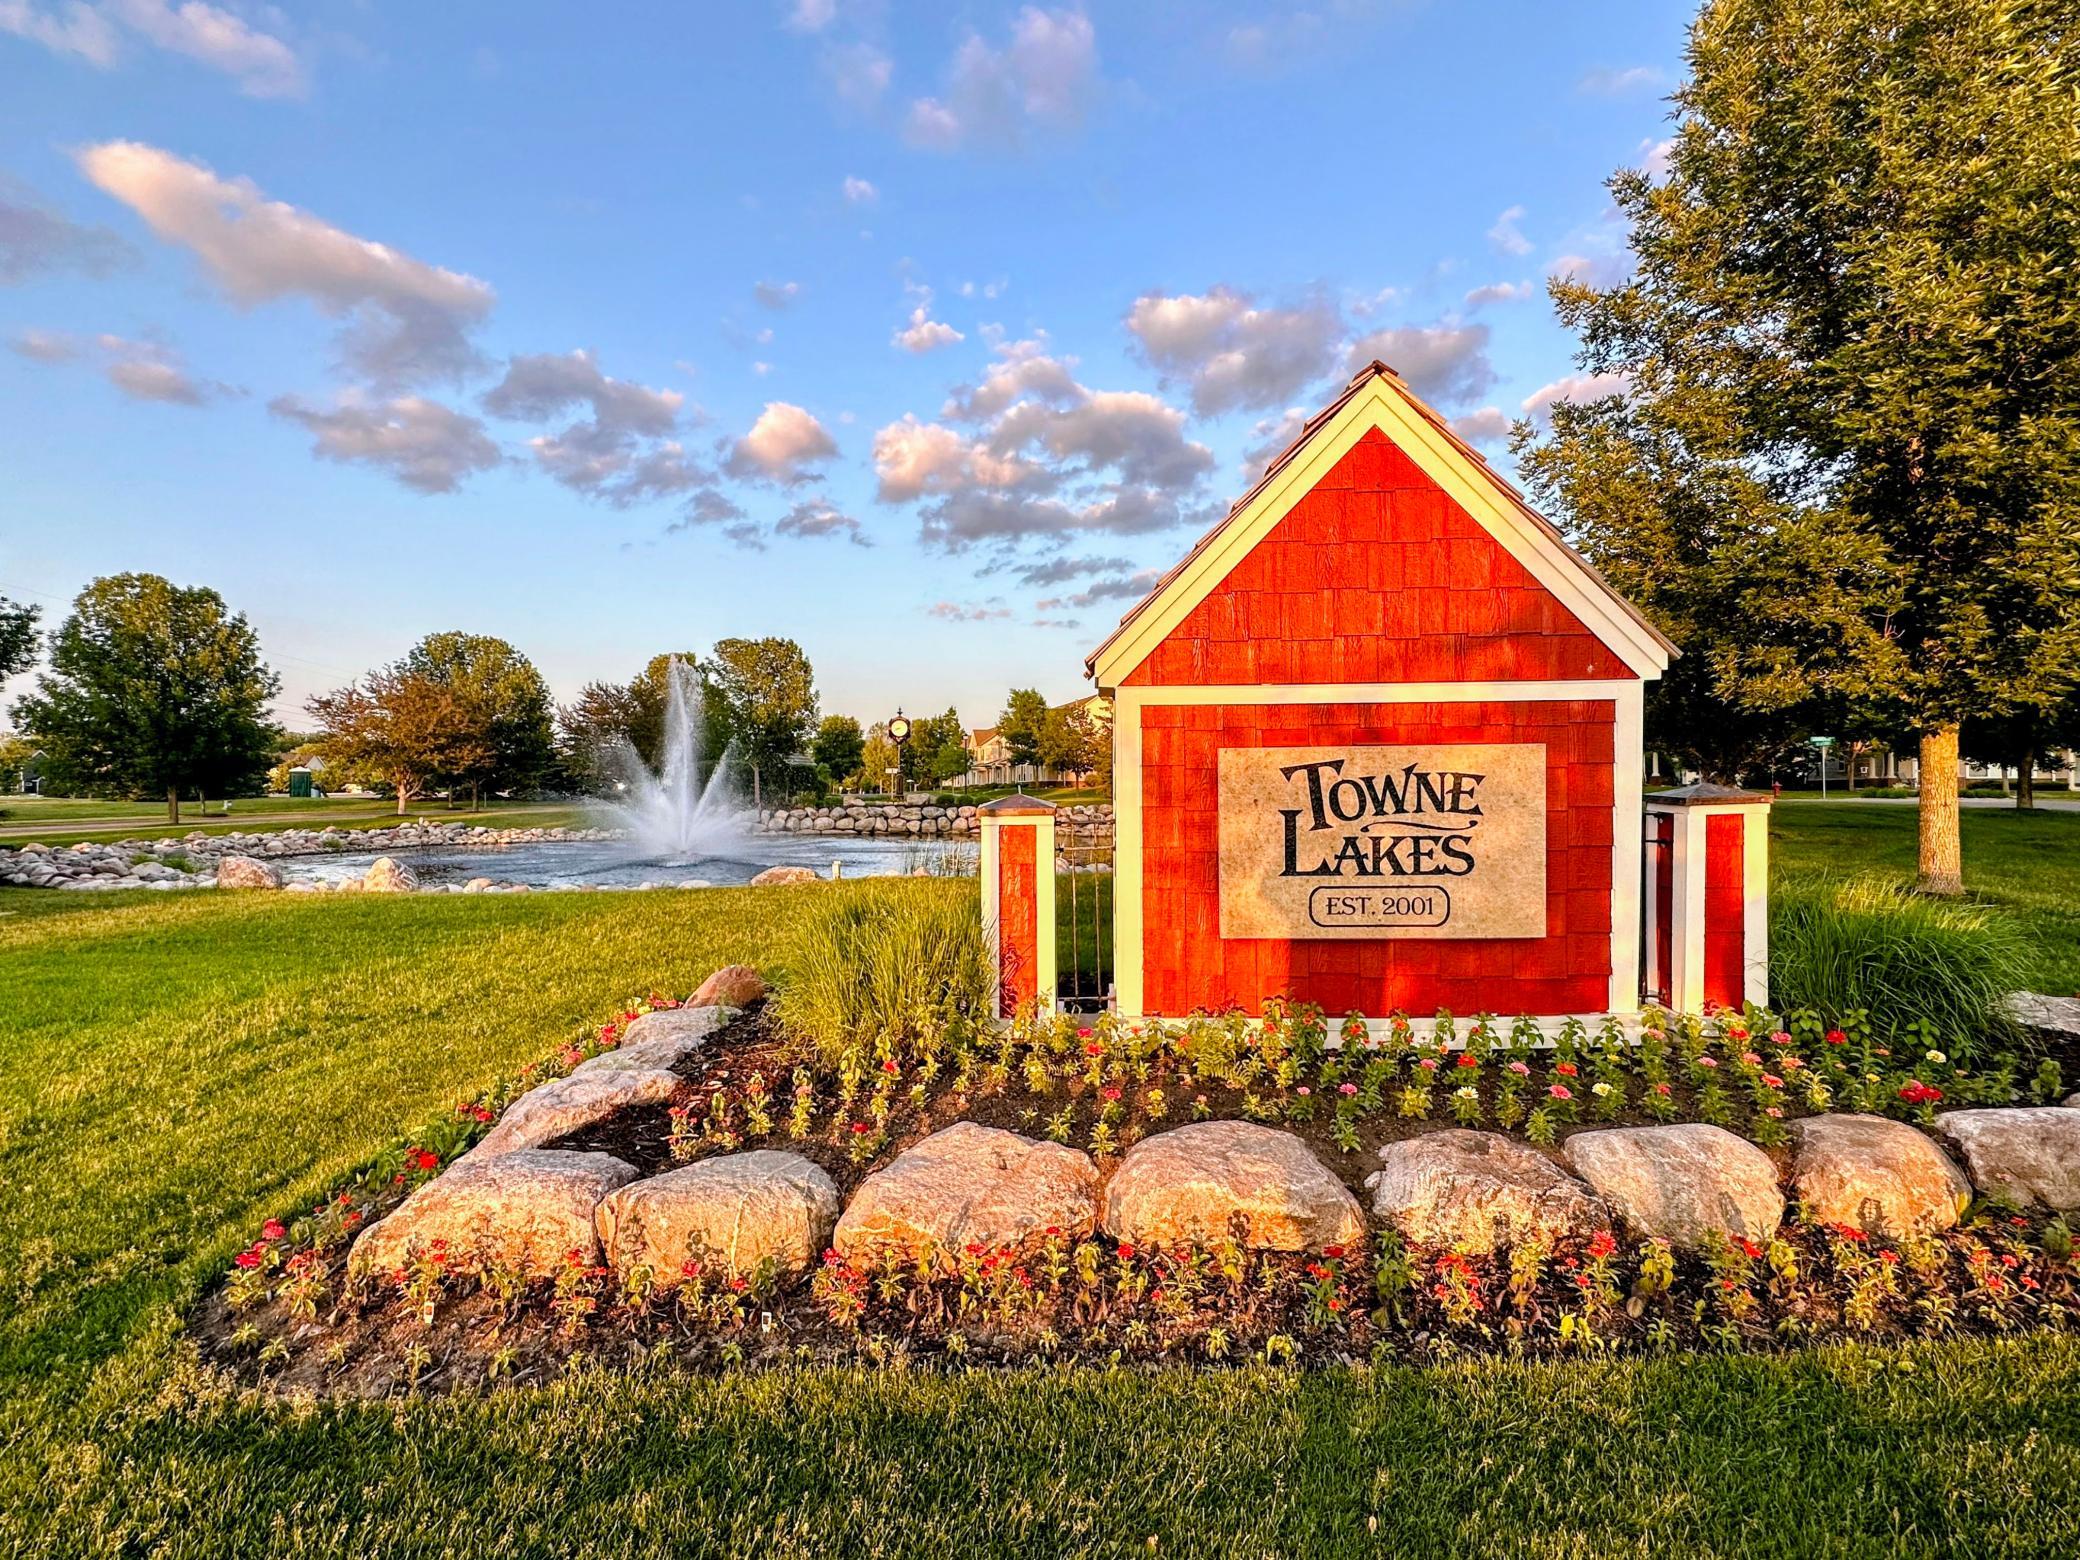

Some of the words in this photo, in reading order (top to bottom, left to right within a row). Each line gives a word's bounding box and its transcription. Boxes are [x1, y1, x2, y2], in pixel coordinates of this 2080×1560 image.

[1279, 759, 1486, 831] TOWNE
[1278, 809, 1474, 877] LAKES
[1326, 897, 1376, 916] EST.
[1382, 896, 1434, 916] 2001
